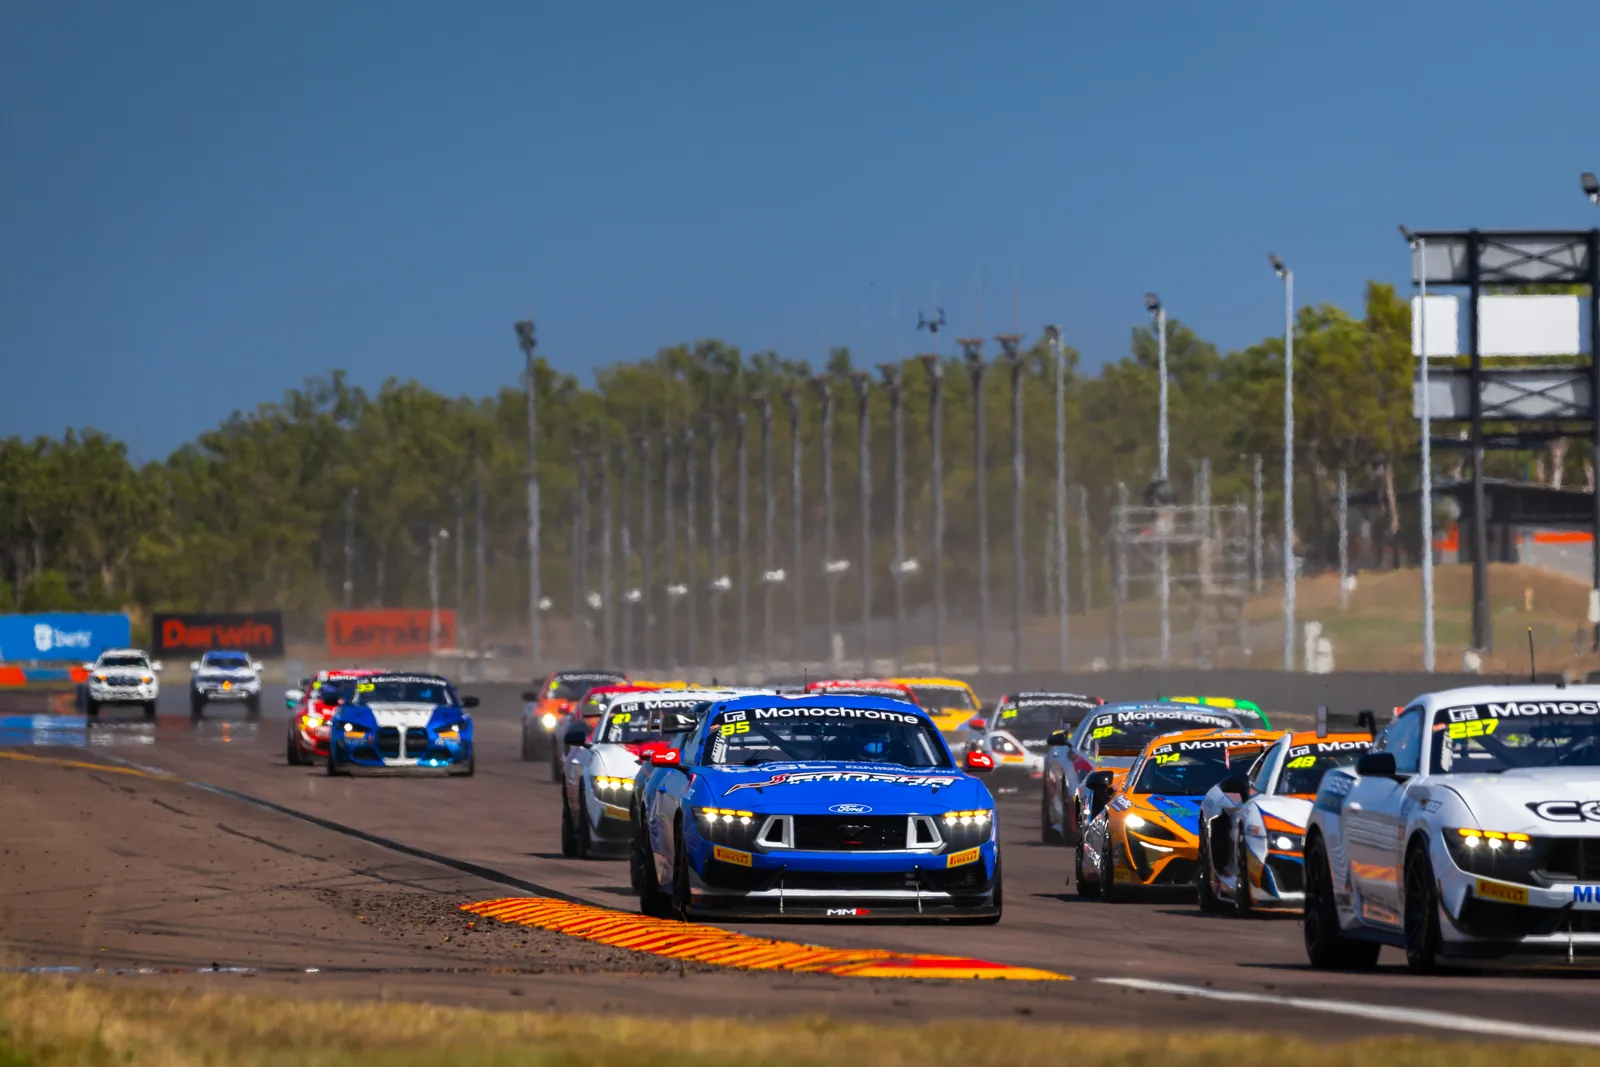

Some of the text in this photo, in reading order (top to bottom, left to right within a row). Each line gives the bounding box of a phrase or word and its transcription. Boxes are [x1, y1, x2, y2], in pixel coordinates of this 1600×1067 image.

[162, 619, 273, 647] Darwin
[755, 707, 919, 724] Monochrome
[1487, 702, 1600, 717] Monoc
[1118, 711, 1232, 728] Monochrome
[721, 721, 750, 736] 95
[1448, 718, 1499, 739] 227
[1318, 741, 1373, 752] Mon
[1155, 754, 1180, 764] 114
[949, 849, 978, 866] PIRELLI
